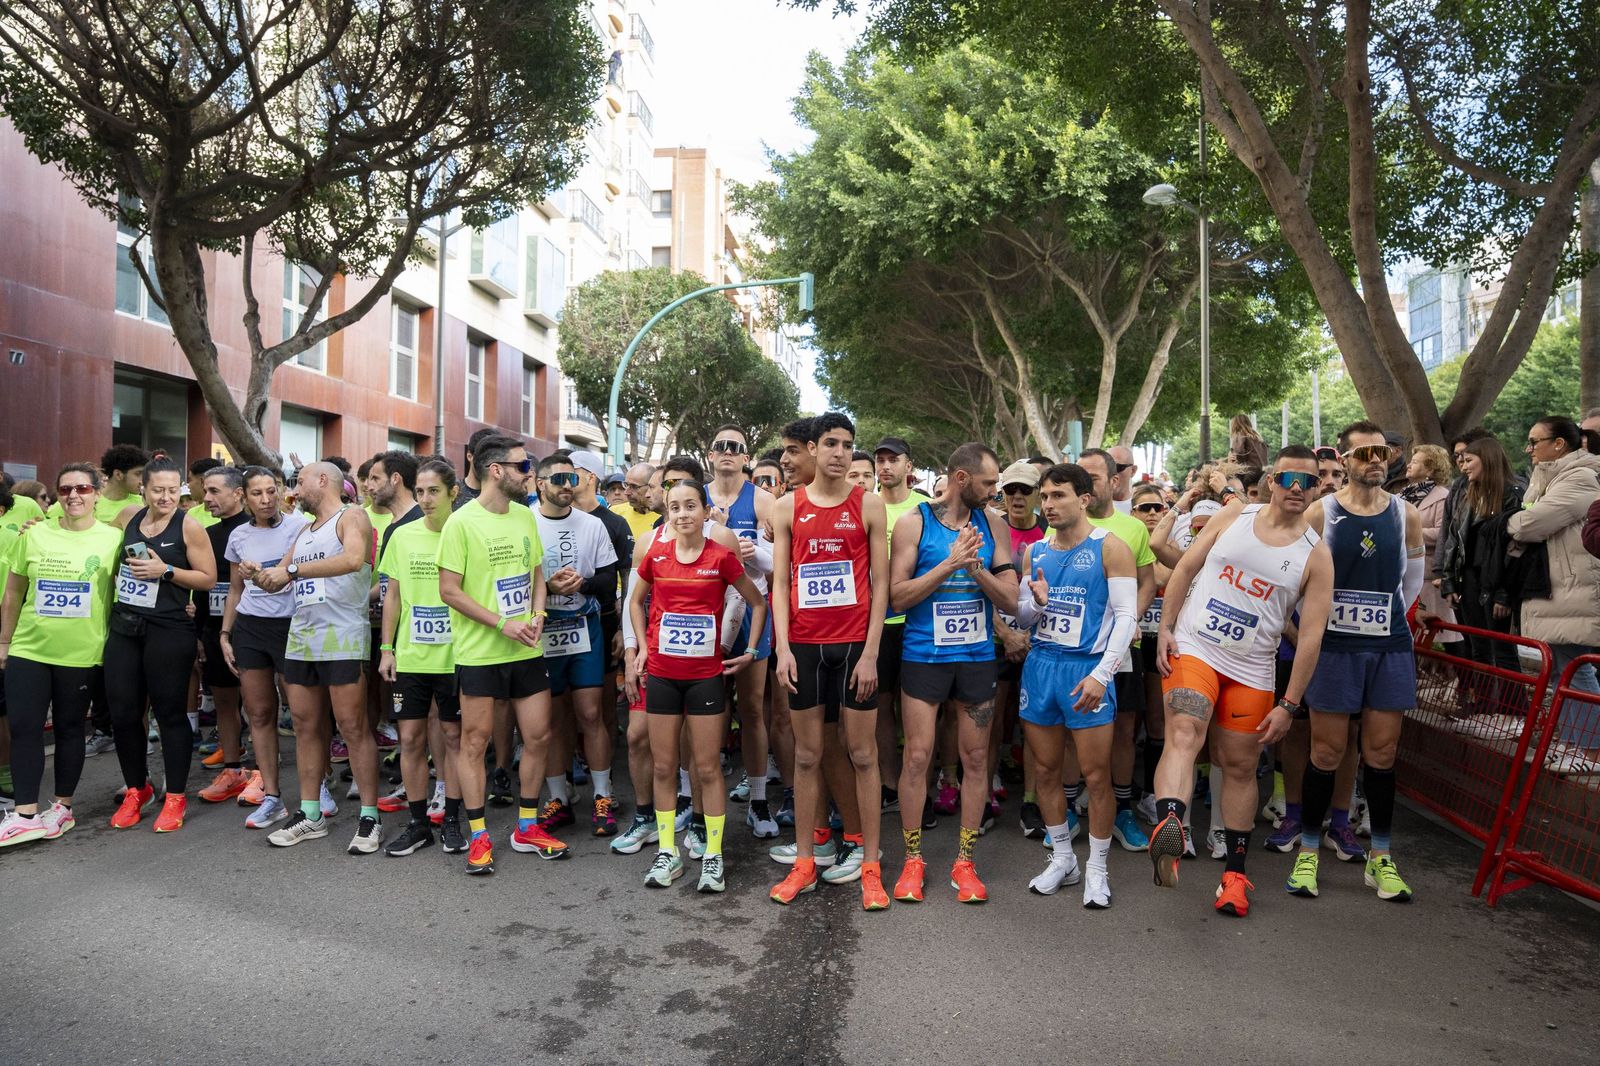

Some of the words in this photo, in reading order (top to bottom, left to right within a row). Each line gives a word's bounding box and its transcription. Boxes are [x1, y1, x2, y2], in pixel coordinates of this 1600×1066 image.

[120, 580, 148, 596] 292
[808, 578, 846, 596] 884
[1218, 564, 1276, 602] ALSI
[44, 594, 82, 608] 294
[502, 586, 531, 606] 104
[1210, 606, 1224, 614] contra
[1335, 606, 1387, 624] 1136
[945, 616, 978, 633] 621
[1040, 614, 1070, 634] 813
[1206, 616, 1245, 641] 349
[549, 631, 580, 647] 320
[669, 630, 706, 645] 232
